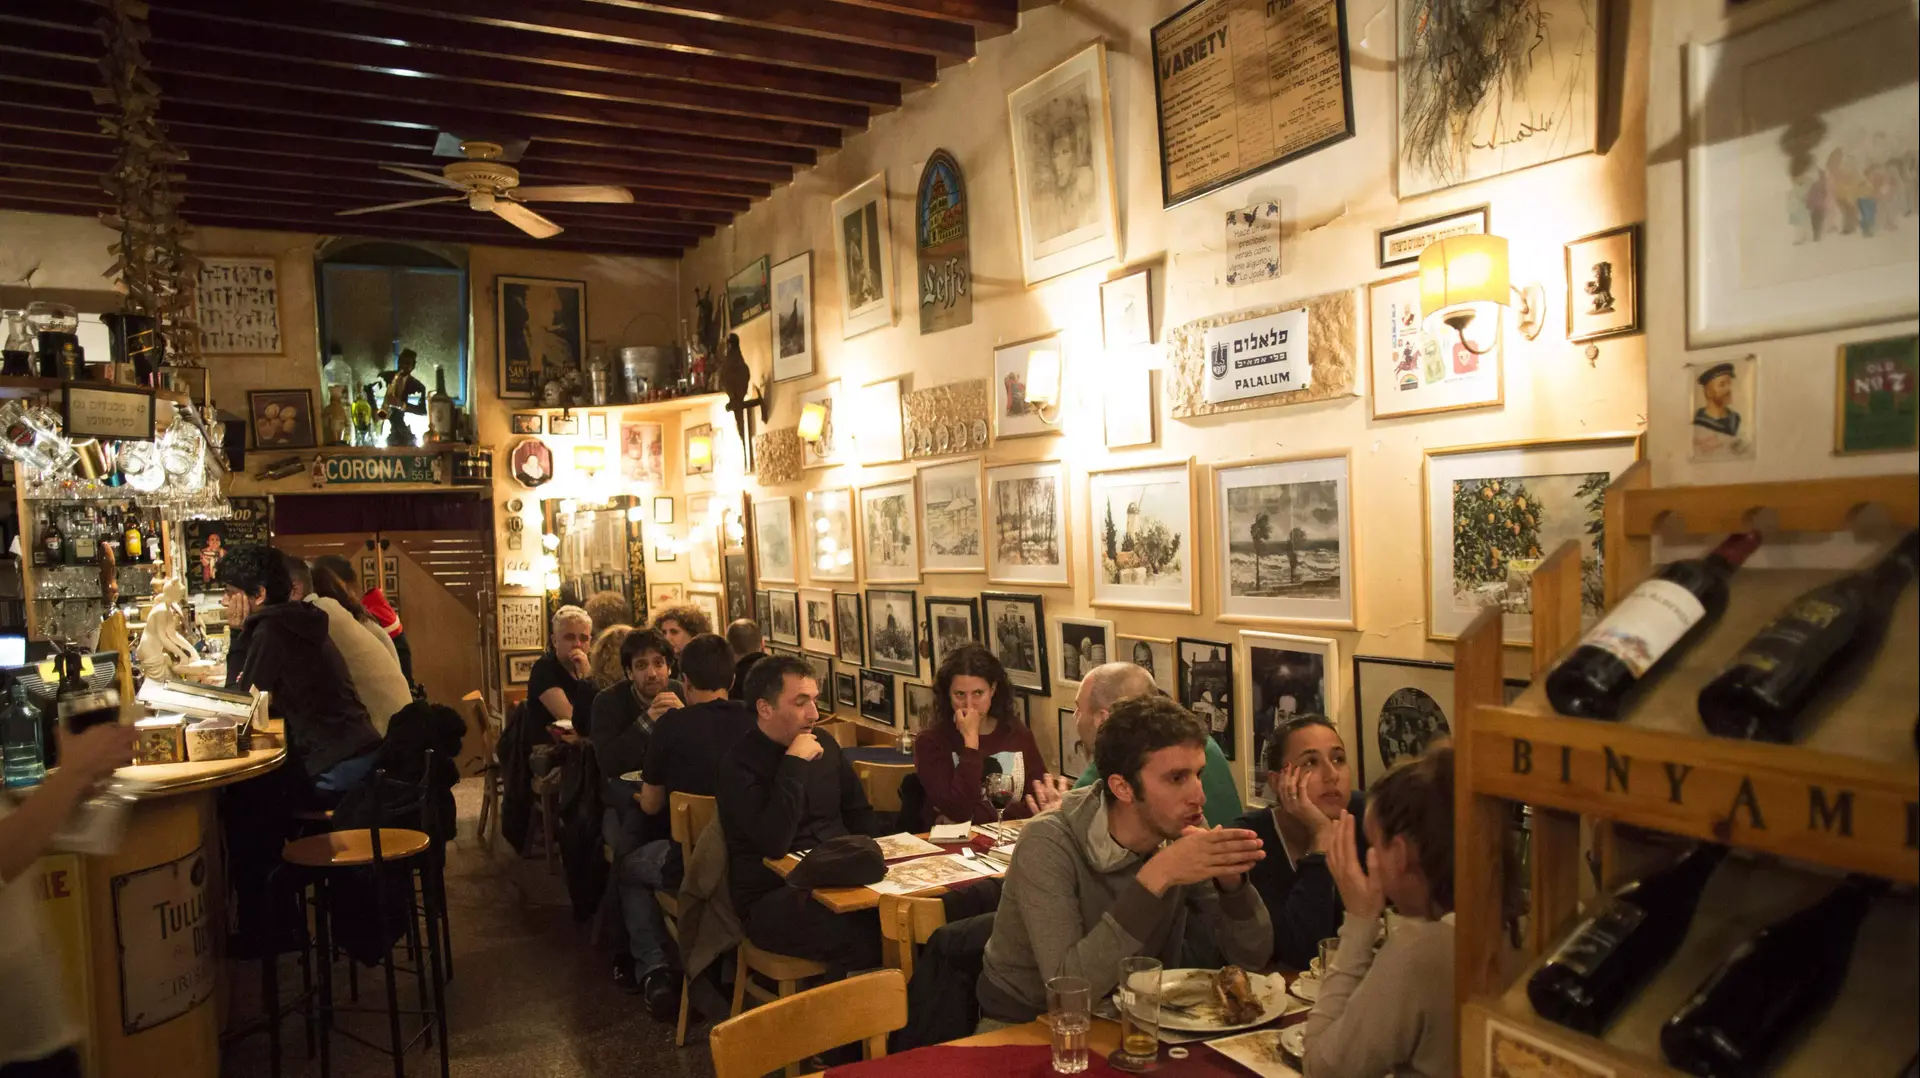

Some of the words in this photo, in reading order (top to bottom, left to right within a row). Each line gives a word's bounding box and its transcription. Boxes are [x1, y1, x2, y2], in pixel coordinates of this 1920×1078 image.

[1160, 24, 1228, 80] VARIETY
[921, 256, 967, 310] Leffe
[1233, 327, 1288, 354] פלאלום
[1235, 371, 1290, 390] PALALUM
[326, 458, 406, 480] CORONA
[414, 456, 428, 467] ST
